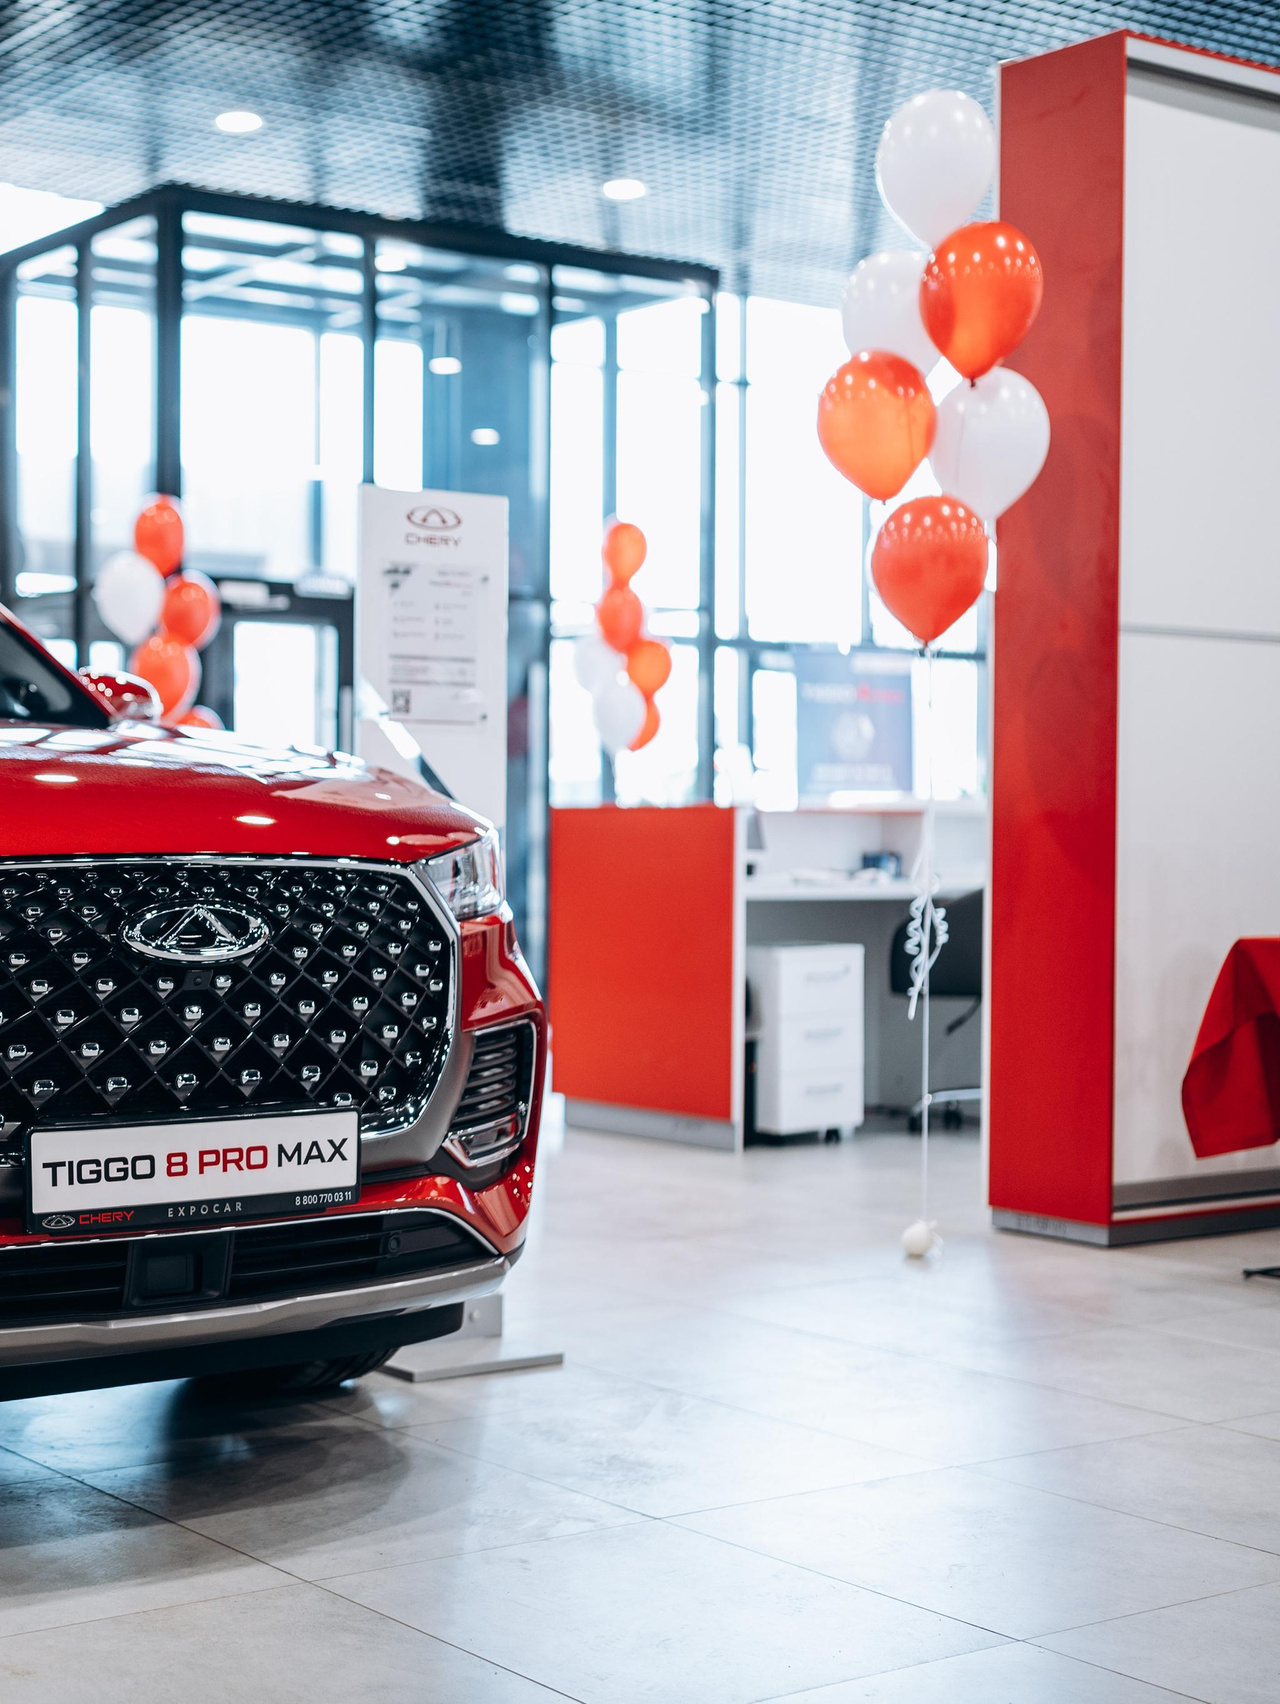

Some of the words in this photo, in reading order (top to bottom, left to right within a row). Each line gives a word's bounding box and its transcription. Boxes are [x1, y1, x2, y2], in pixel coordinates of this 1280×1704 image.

[405, 532, 461, 548] CHERY
[42, 1154, 156, 1187] TIGGO
[166, 1151, 189, 1178] 8
[198, 1145, 269, 1175] PRO
[277, 1137, 349, 1168] MAX
[302, 1194, 318, 1206] 800
[319, 1192, 333, 1204] 770
[333, 1191, 344, 1202] 03
[344, 1190, 352, 1201] 11
[167, 1201, 243, 1218] EXPOCAR
[78, 1210, 135, 1226] CHERY
